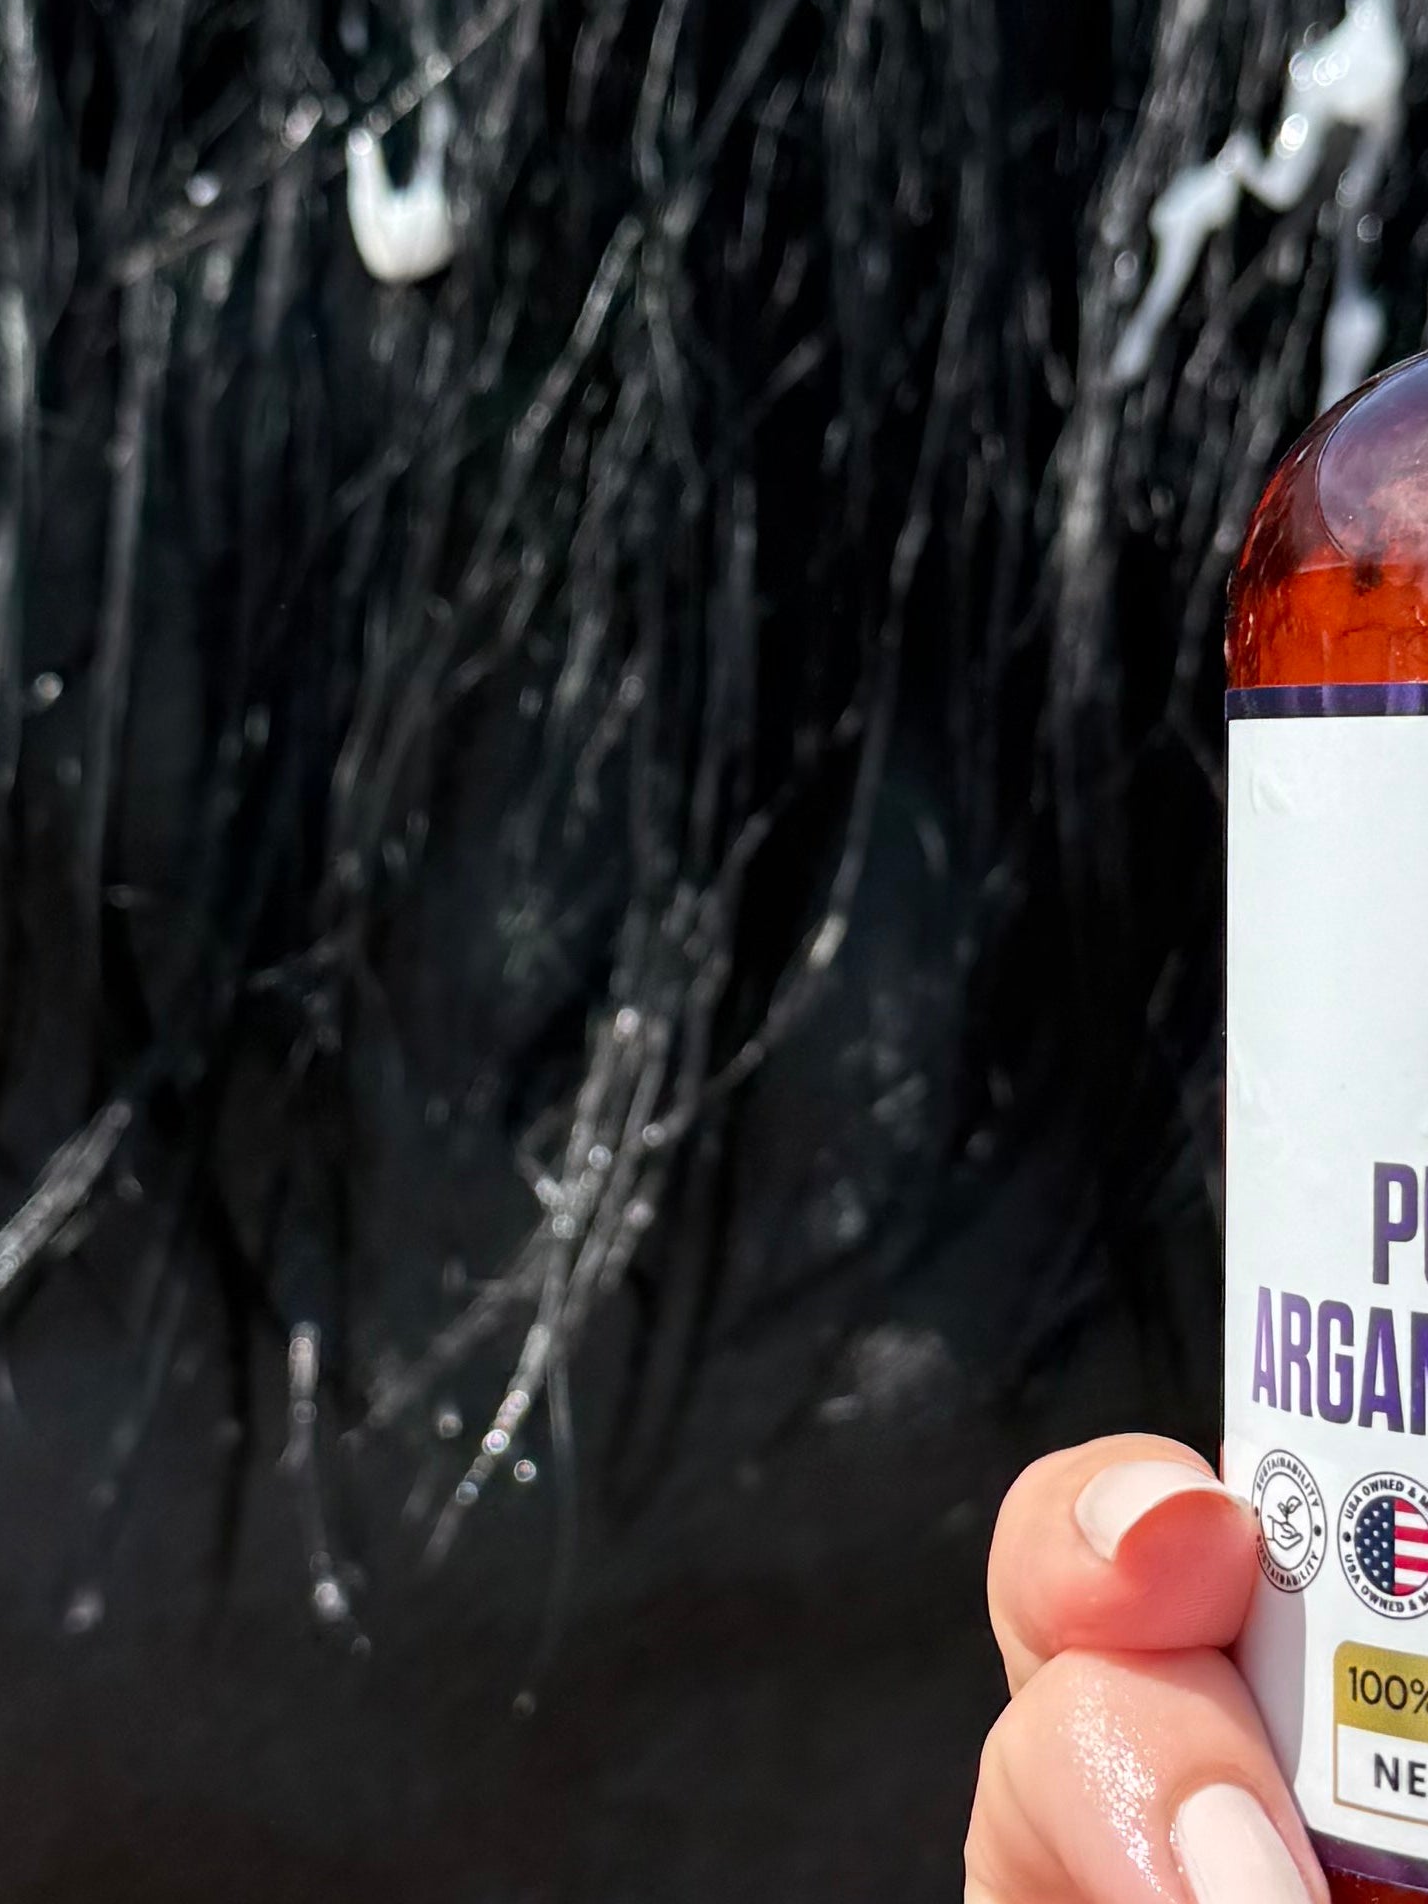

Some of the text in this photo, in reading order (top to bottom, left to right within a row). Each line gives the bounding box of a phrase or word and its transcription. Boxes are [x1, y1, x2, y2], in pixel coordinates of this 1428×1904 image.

[1344, 1494, 1363, 1520] USA
[1361, 1478, 1405, 1497] OWNED
[1407, 1486, 1417, 1500] &
[1344, 1553, 1361, 1585] USA
[1360, 1585, 1406, 1613] OWNED
